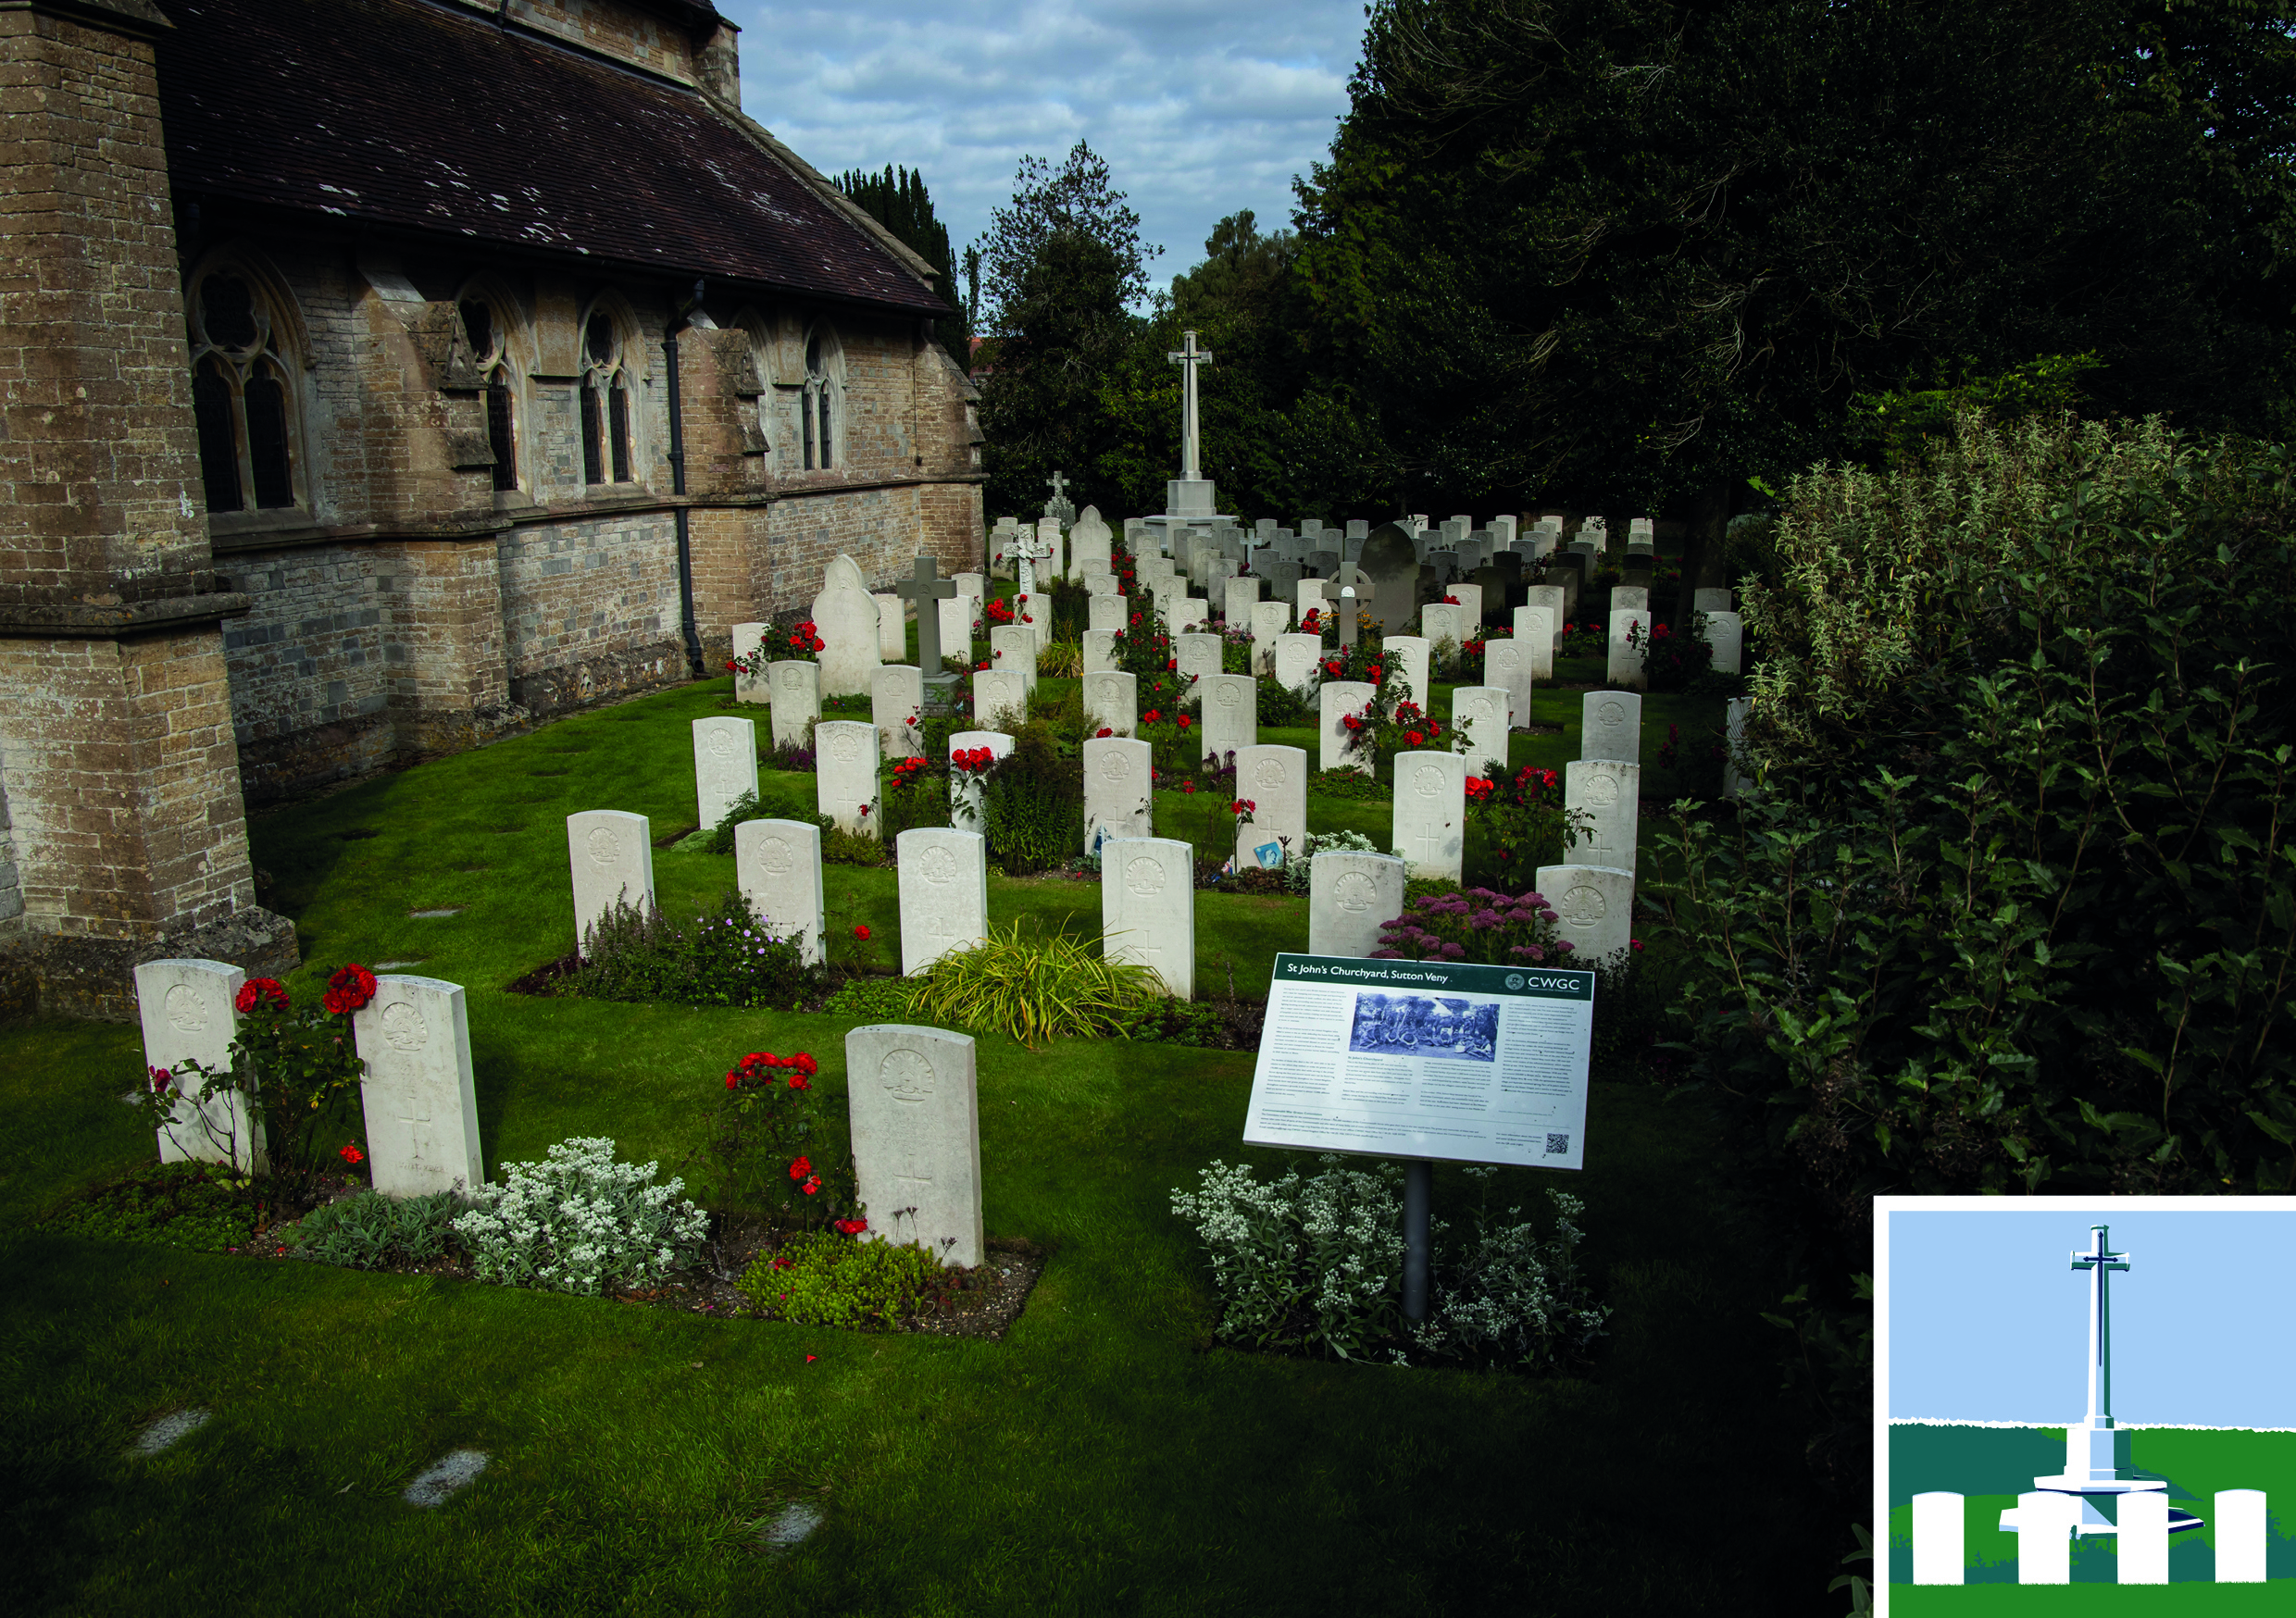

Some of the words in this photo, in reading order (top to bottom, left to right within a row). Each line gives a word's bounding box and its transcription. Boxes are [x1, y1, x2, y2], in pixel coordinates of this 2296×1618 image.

[1287, 964, 1297, 972] St
[1298, 964, 1328, 975] John's
[1330, 965, 1389, 980] Churchyard,
[1391, 969, 1424, 980] Sutton
[1424, 972, 1449, 985] Veny
[1529, 977, 1579, 990] CWGC
